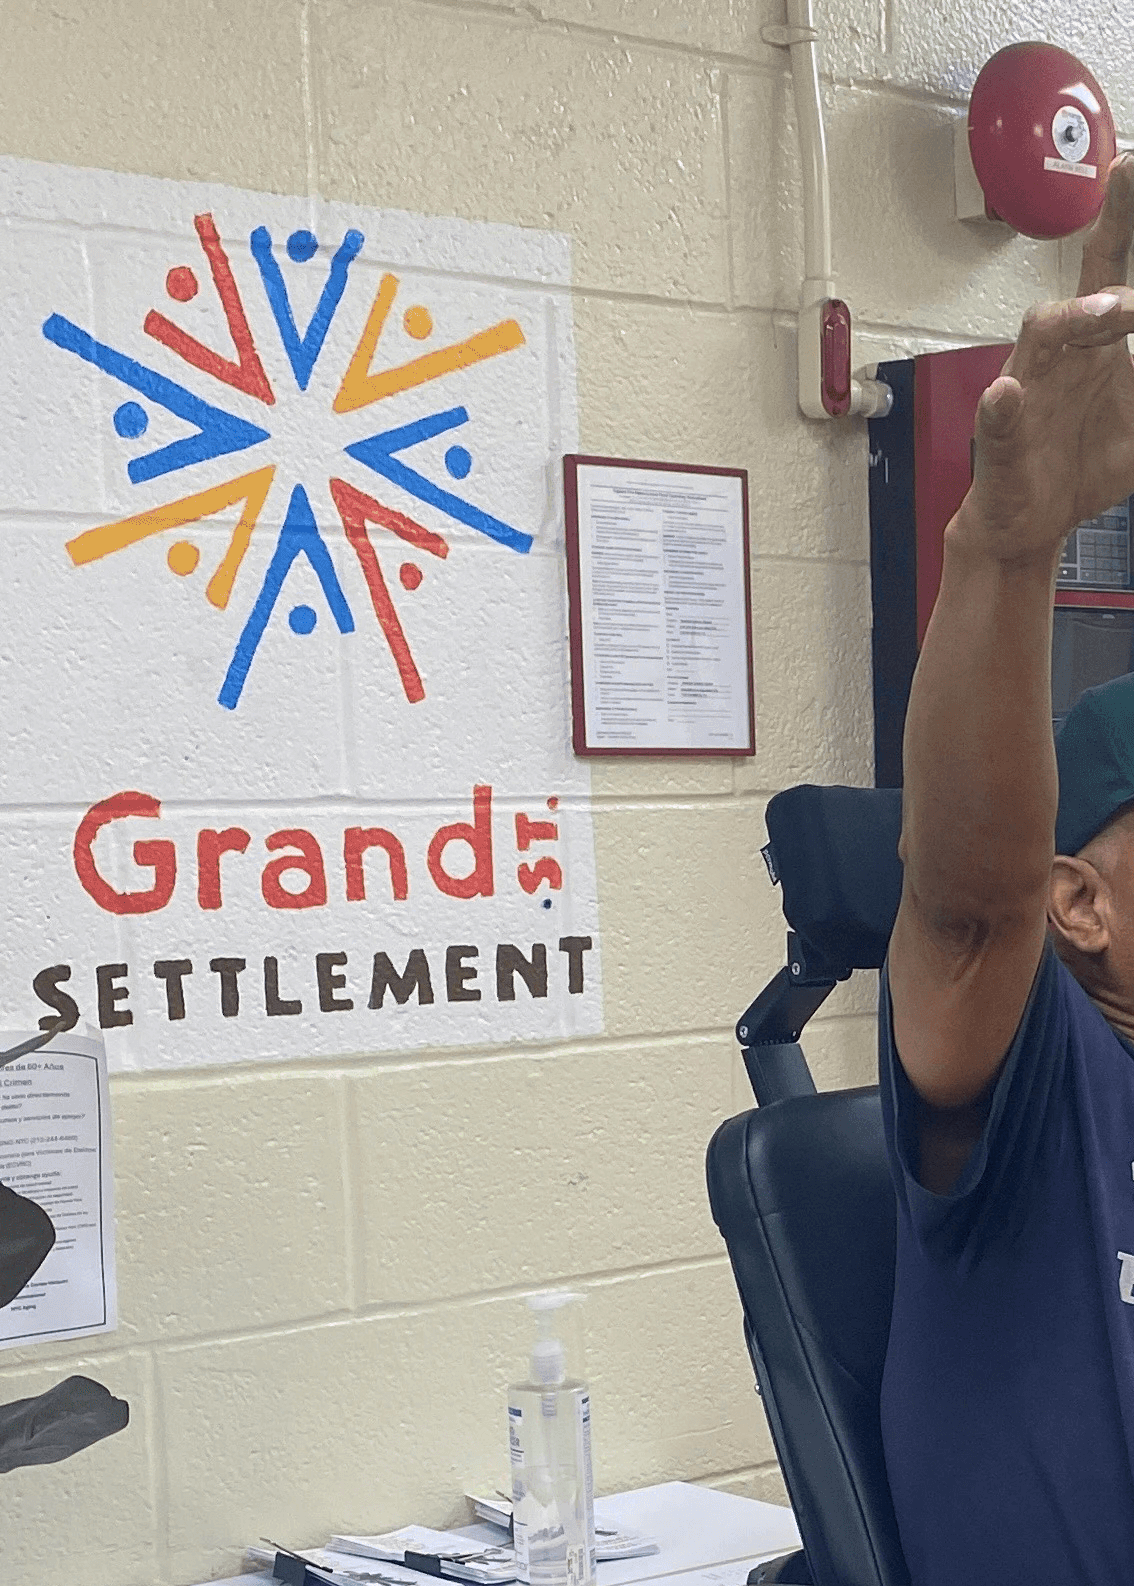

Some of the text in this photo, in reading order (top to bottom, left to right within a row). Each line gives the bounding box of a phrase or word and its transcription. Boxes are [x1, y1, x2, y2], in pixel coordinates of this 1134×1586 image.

[73, 784, 494, 915] Grand
[515, 796, 563, 895] ST.
[32, 935, 593, 1032] SETTLEMENT
